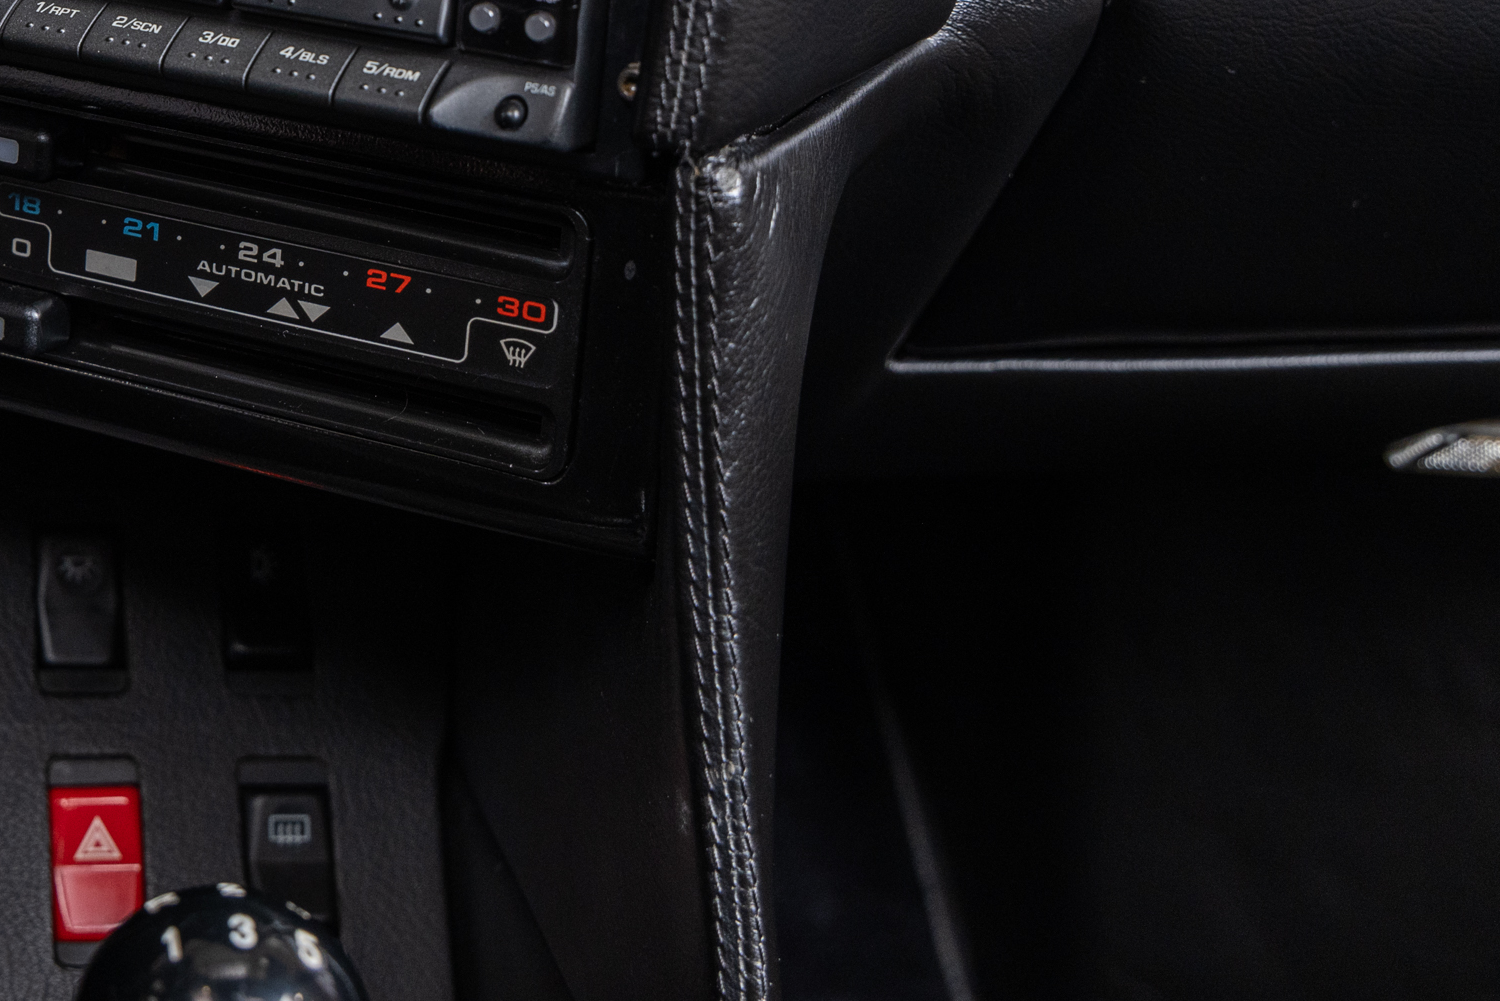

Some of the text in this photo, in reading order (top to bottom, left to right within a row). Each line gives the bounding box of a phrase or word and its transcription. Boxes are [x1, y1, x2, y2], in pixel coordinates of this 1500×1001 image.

[35, 1, 81, 19] 1/RPT
[111, 16, 163, 34] 2/SCN
[279, 46, 330, 66] 4/BLS
[362, 60, 421, 82] 5/RDM
[524, 81, 556, 97] PS/AS
[8, 192, 546, 323] 18 21 24 27 30
[197, 260, 324, 297] AUTOMATIC
[160, 925, 183, 963] 1
[227, 912, 259, 950] 3
